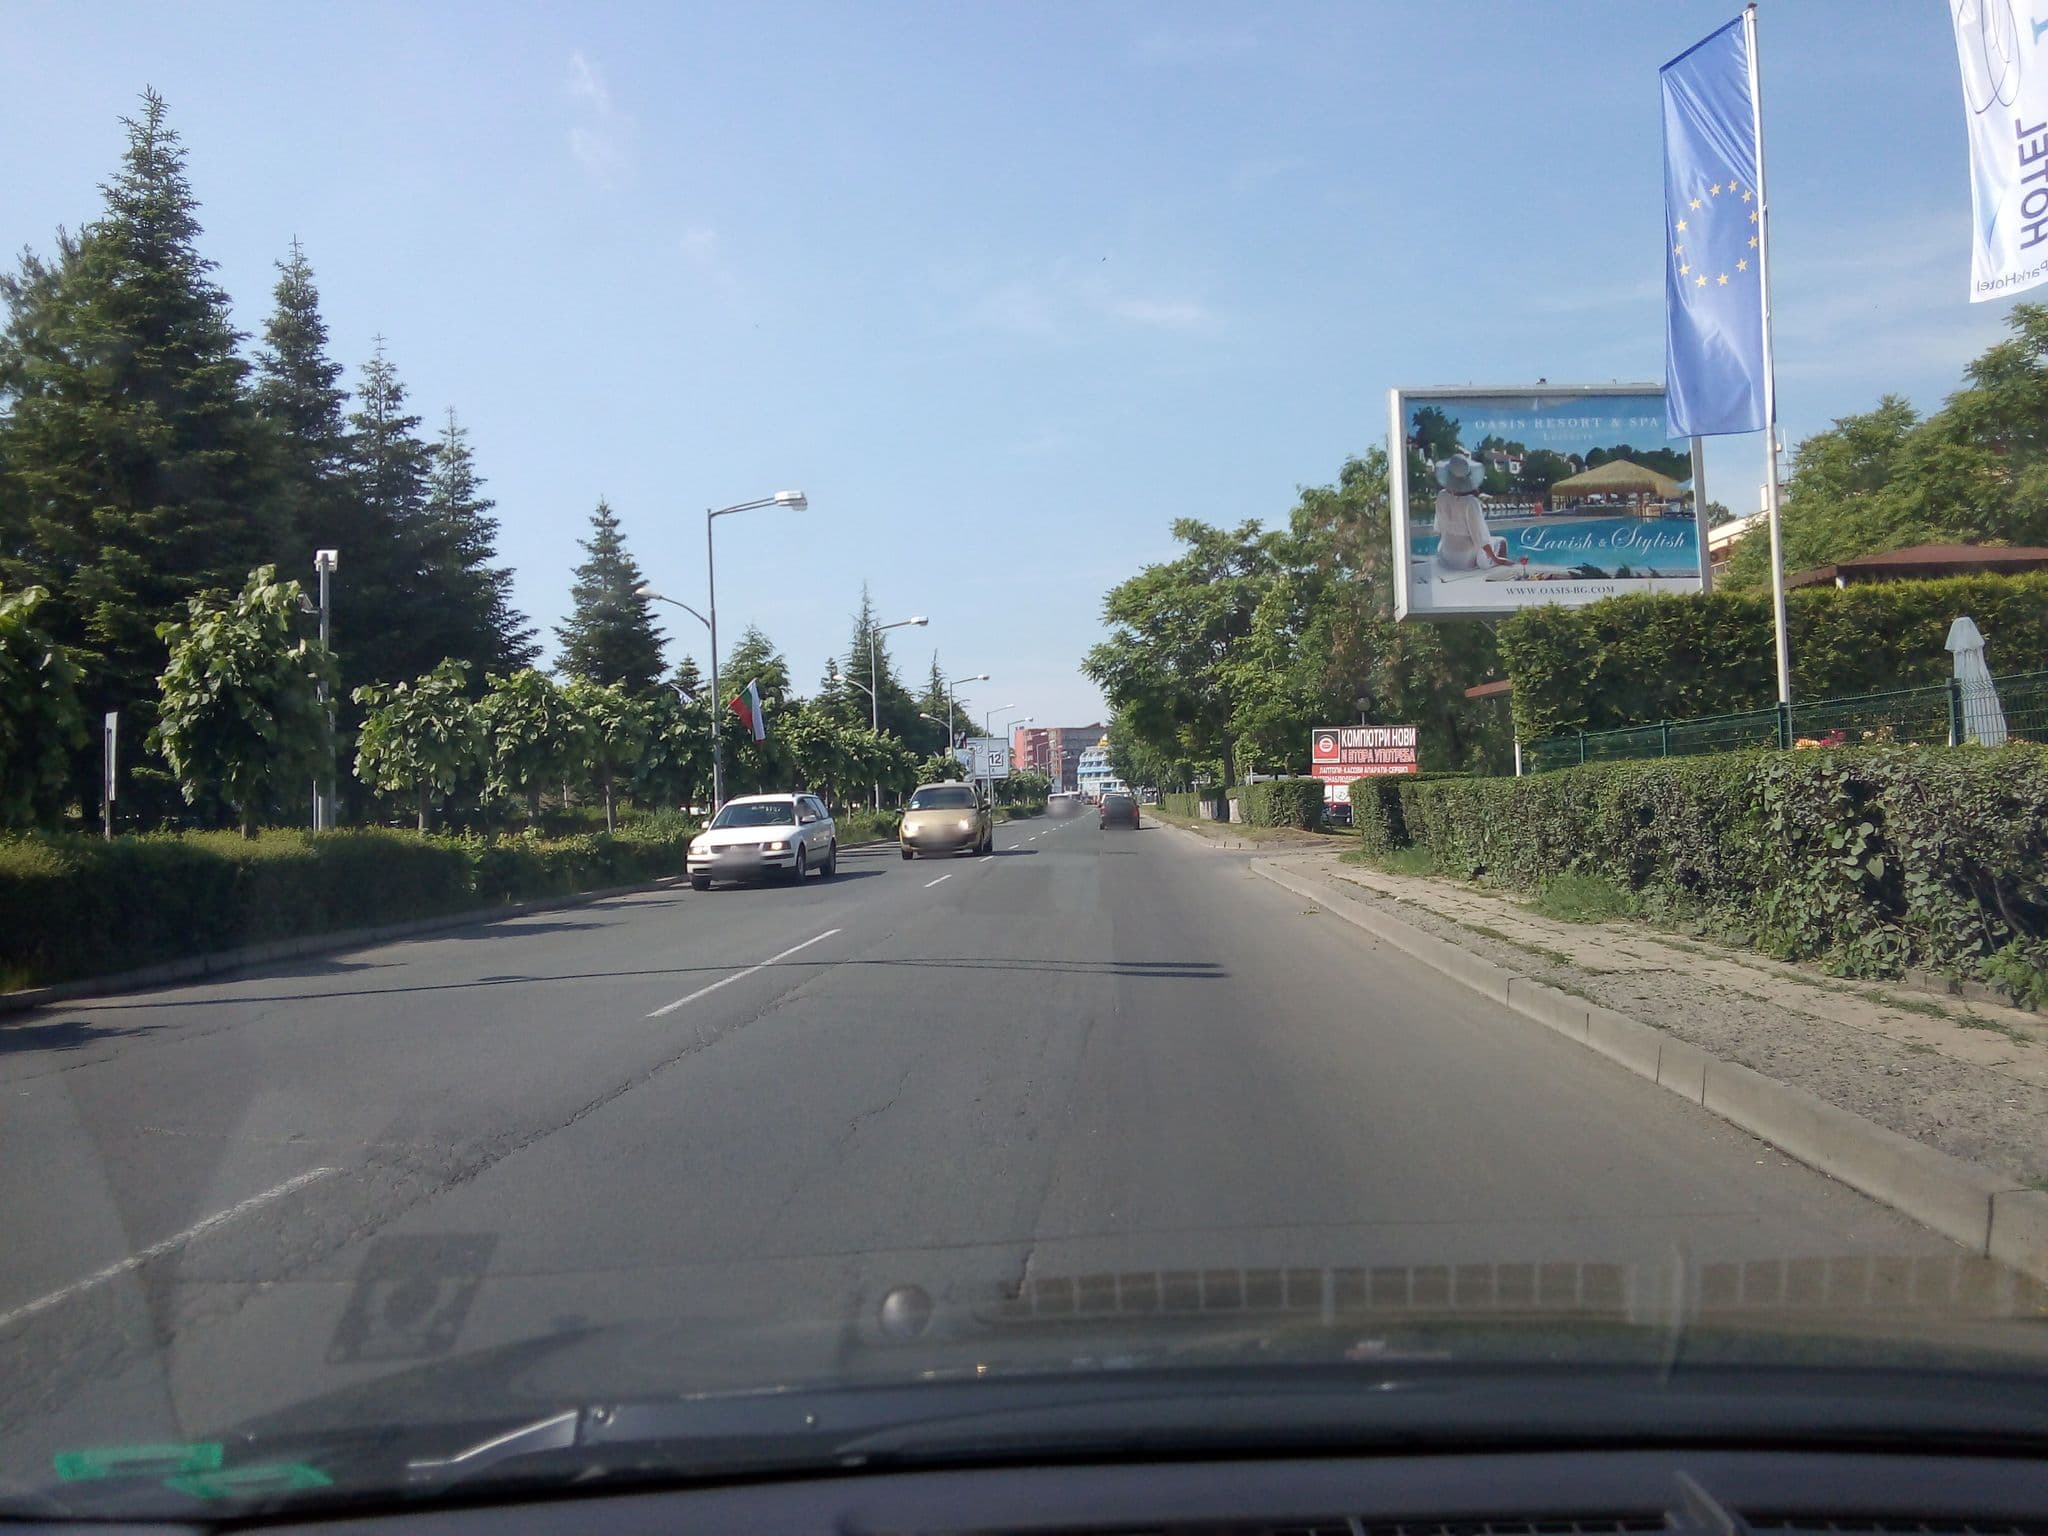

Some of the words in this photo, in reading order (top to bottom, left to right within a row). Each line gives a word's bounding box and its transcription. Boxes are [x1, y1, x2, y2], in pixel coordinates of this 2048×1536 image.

[1475, 419, 1525, 431] OASIS
[1534, 417, 1602, 429] RESORT
[1609, 417, 1620, 428] &
[1629, 417, 1659, 428] SPA
[1519, 526, 1593, 552] Lavish
[1598, 538, 1607, 548] &
[1611, 526, 1685, 557] Stylish
[1505, 585, 1615, 595] WWW.OASIS-BG.COM
[1341, 728, 1391, 747] КОМПЮТРИ
[1392, 728, 1416, 747] НОВИ
[990, 754, 1001, 765] 12
[1348, 748, 1374, 763] ВТОРА
[1374, 748, 1416, 763] УПОТРЕБА
